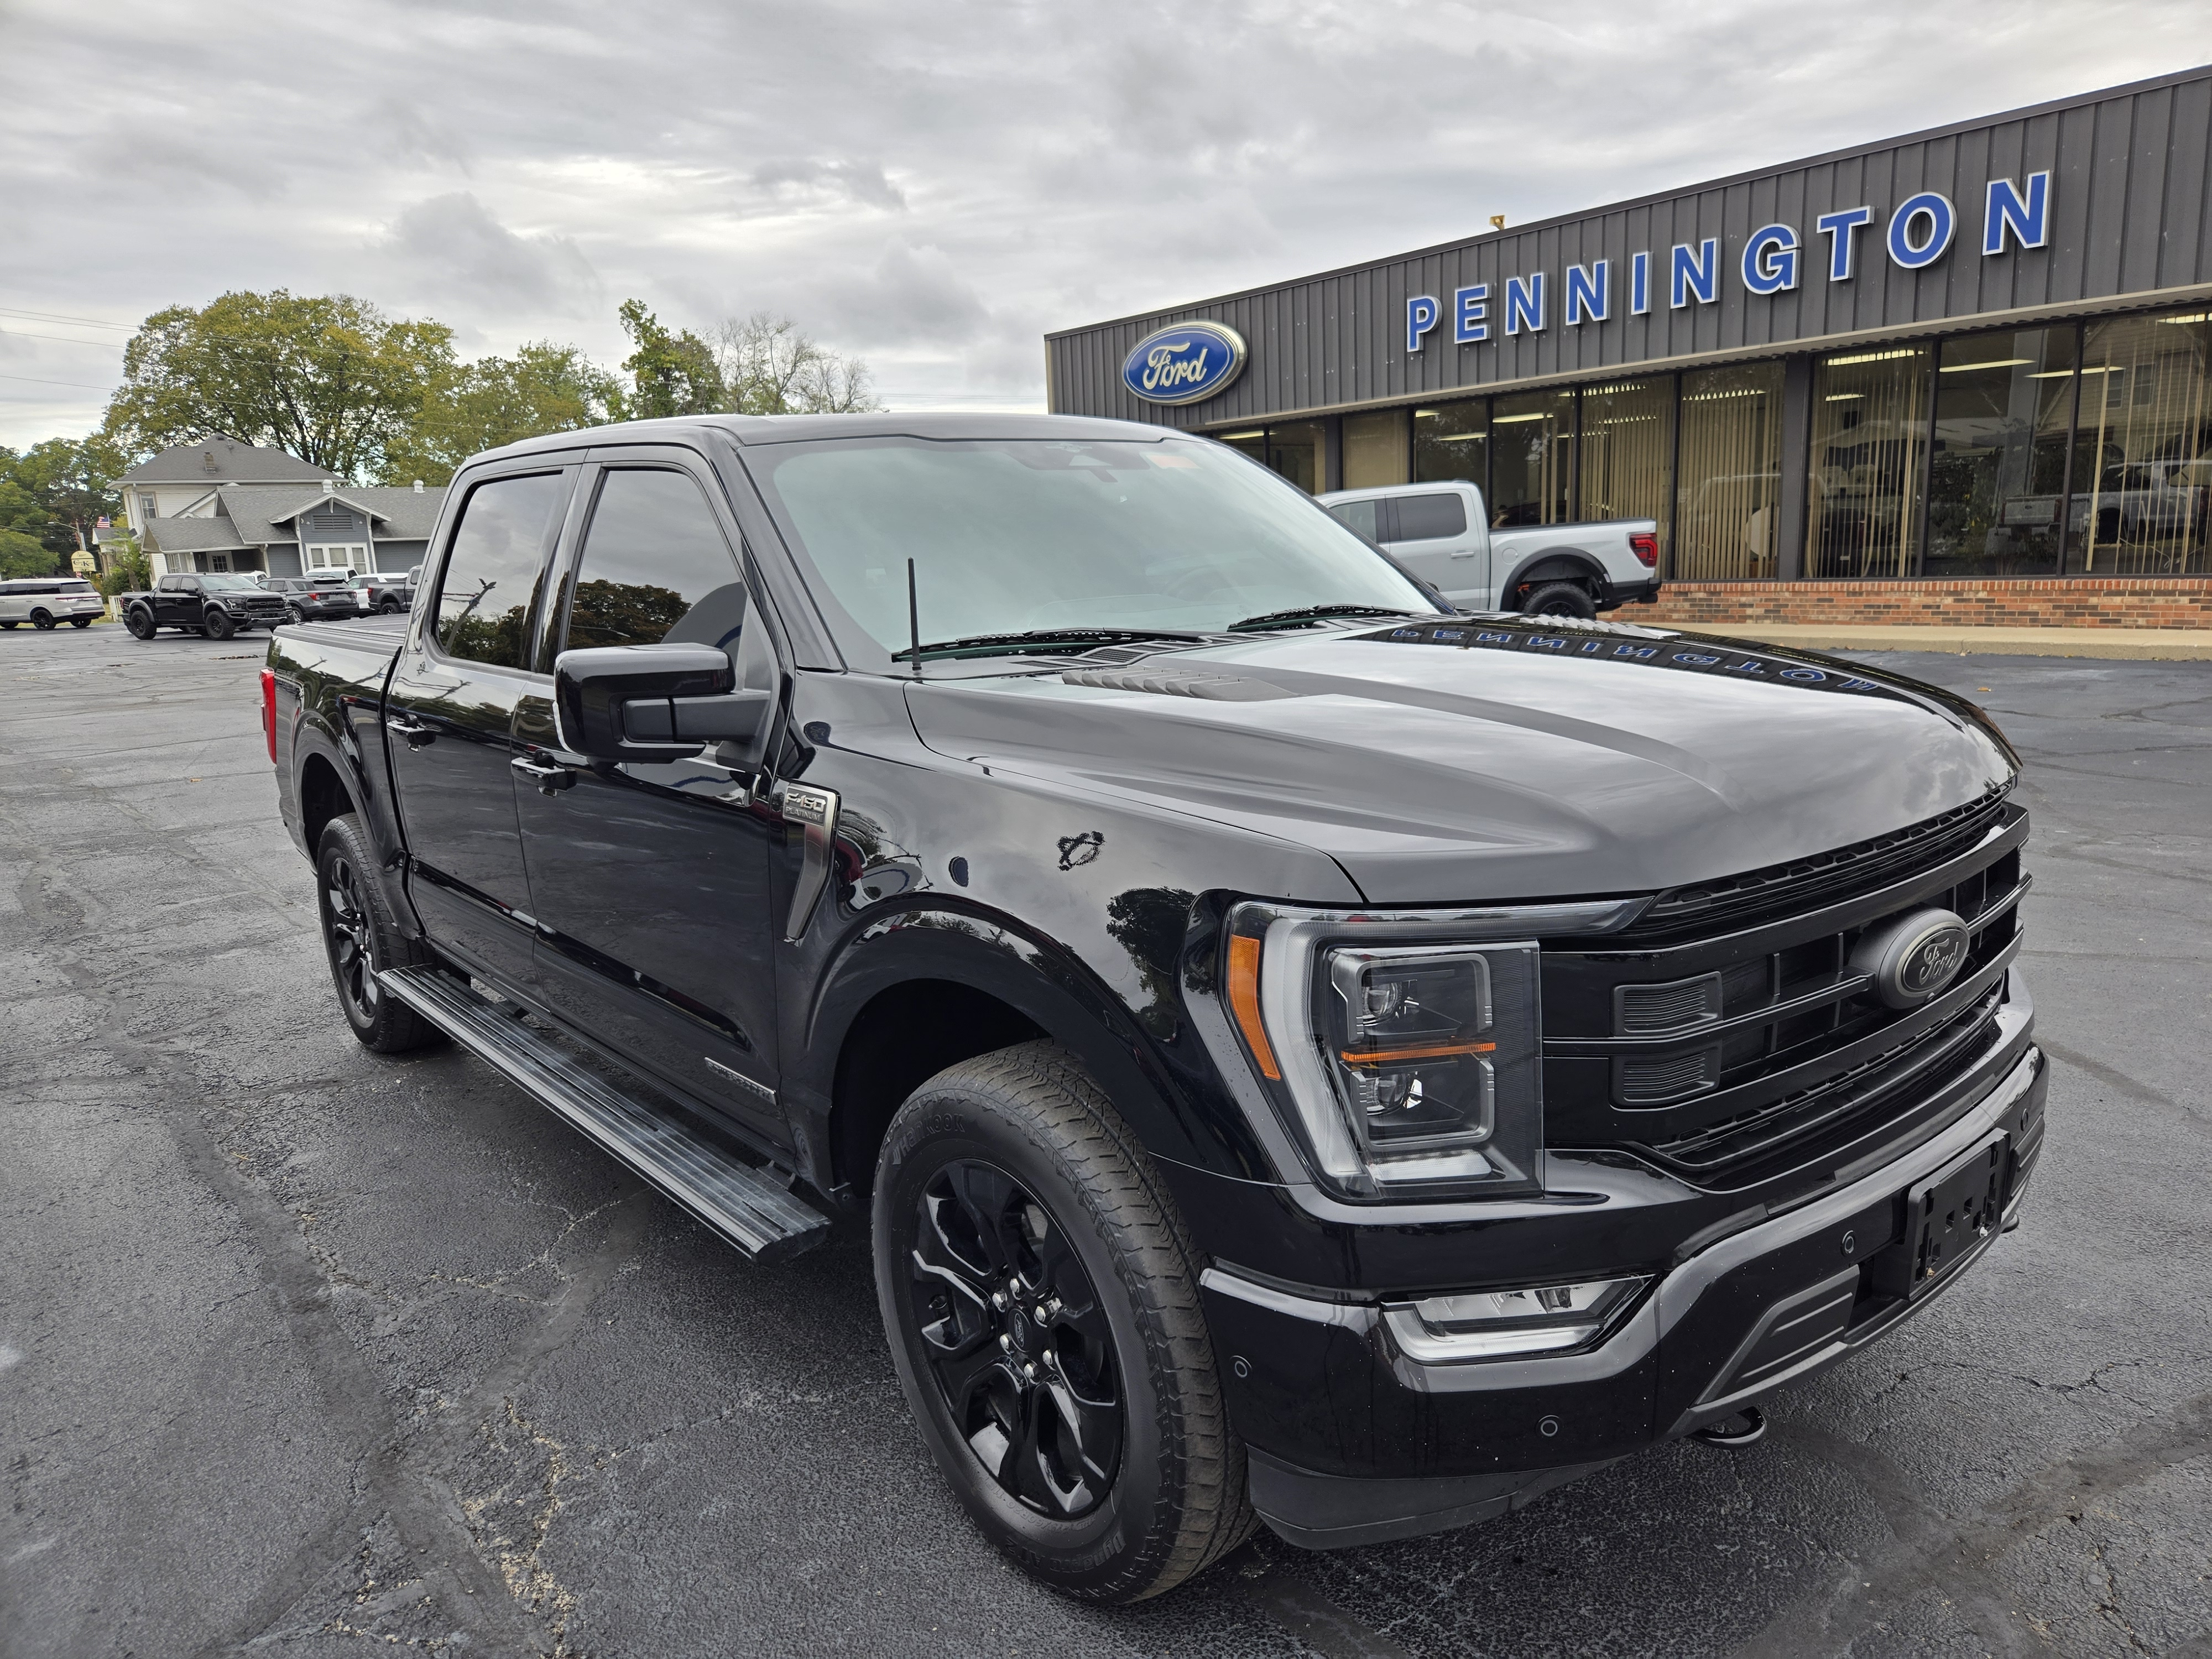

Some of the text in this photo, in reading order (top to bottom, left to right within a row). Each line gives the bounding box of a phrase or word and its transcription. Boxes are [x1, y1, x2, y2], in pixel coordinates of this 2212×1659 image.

[1406, 170, 2052, 352] PENNINGTON
[1142, 342, 1208, 390] Ford
[785, 806, 821, 821] PLATINUM
[786, 792, 826, 812] F-150
[1918, 938, 1959, 985] Ford
